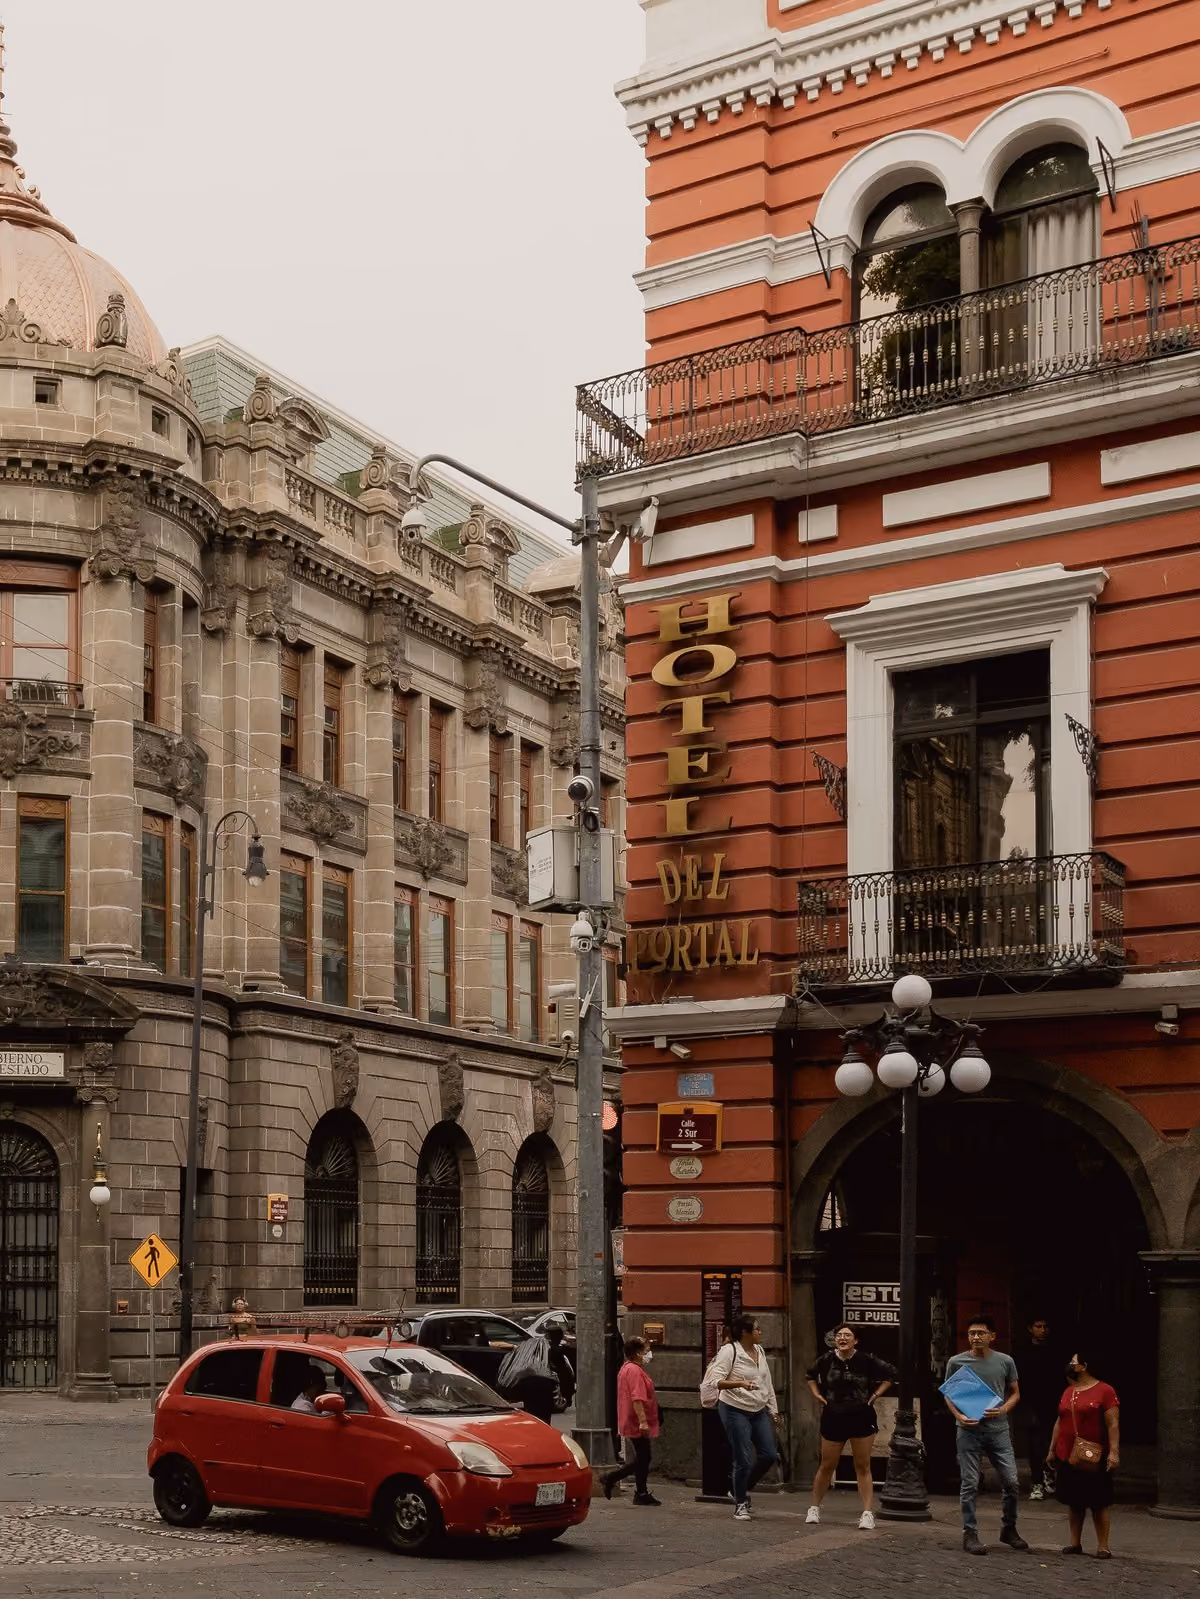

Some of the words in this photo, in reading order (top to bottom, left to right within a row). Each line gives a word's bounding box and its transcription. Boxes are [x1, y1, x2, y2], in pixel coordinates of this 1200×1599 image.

[648, 592, 743, 838] HOTEL
[656, 852, 730, 905] DEL
[631, 919, 759, 975] PORTAL
[0, 1064, 49, 1075] ESTADO
[681, 1119, 696, 1127] Calle
[678, 1128, 683, 1137] 2
[684, 1128, 698, 1137] Sur
[847, 1311, 860, 1321] DE
[865, 1311, 900, 1322] PUEBL
